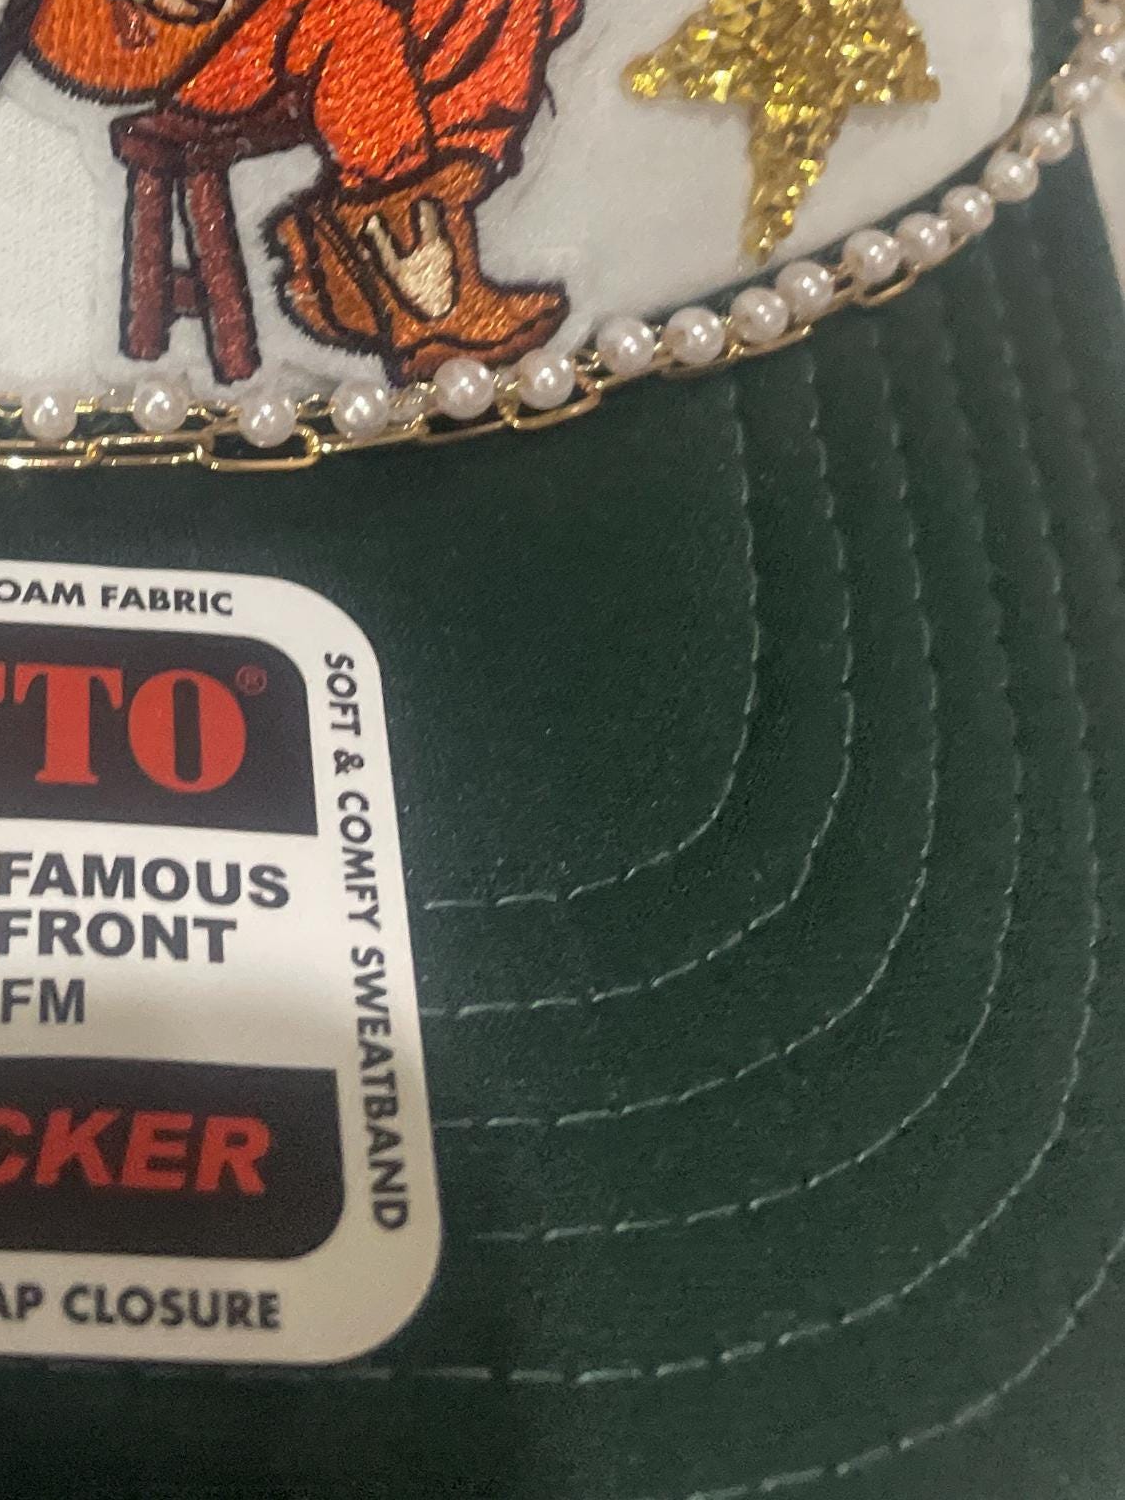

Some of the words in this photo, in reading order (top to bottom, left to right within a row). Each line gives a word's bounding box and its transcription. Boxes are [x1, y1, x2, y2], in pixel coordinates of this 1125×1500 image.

[101, 585, 233, 615] FABRIC
[324, 652, 361, 736] SOFT
[333, 749, 364, 775] &
[337, 790, 381, 932] COMFY
[351, 945, 409, 1231] SWEATBAND
[61, 1283, 281, 1330] CLOSURE
